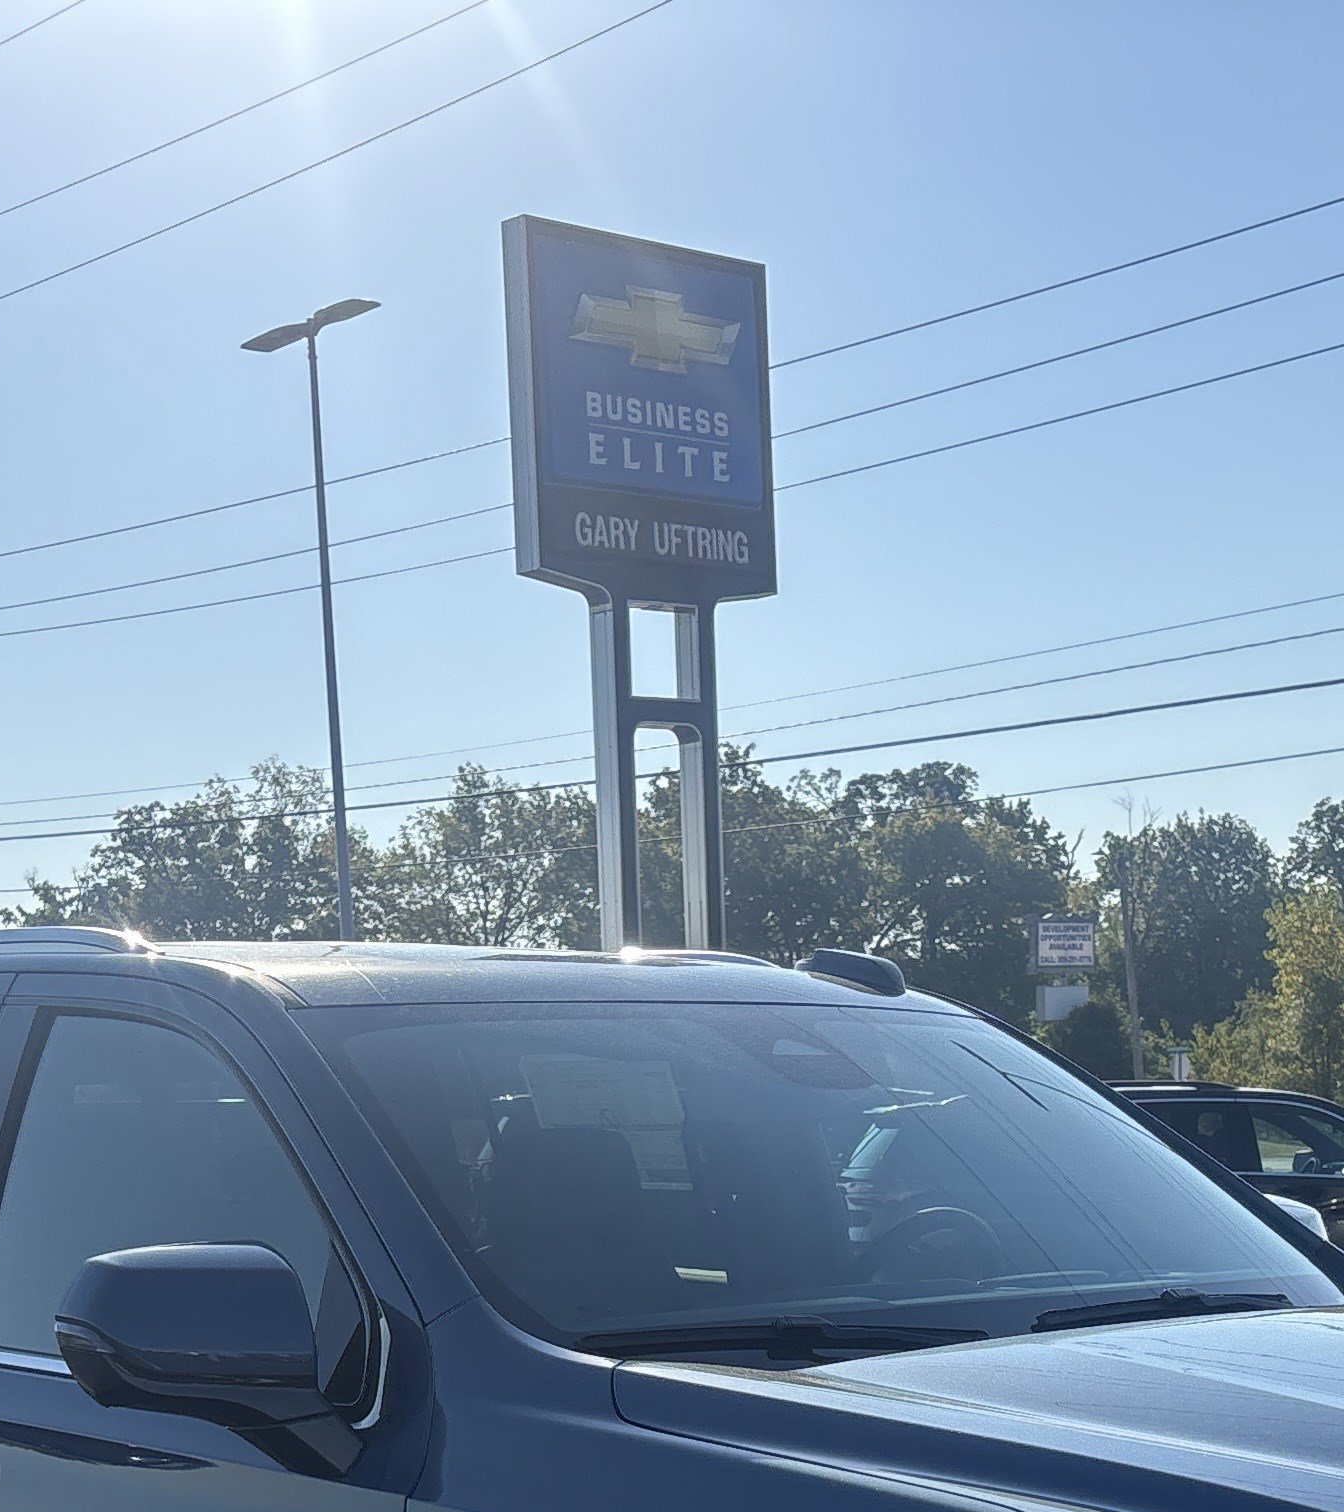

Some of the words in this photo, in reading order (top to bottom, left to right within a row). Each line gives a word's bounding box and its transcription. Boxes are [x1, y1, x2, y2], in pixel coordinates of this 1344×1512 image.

[586, 390, 729, 437] BUSINESS
[588, 432, 731, 482] ELITE
[575, 511, 639, 551] GARY
[653, 521, 750, 565] UFTRING
